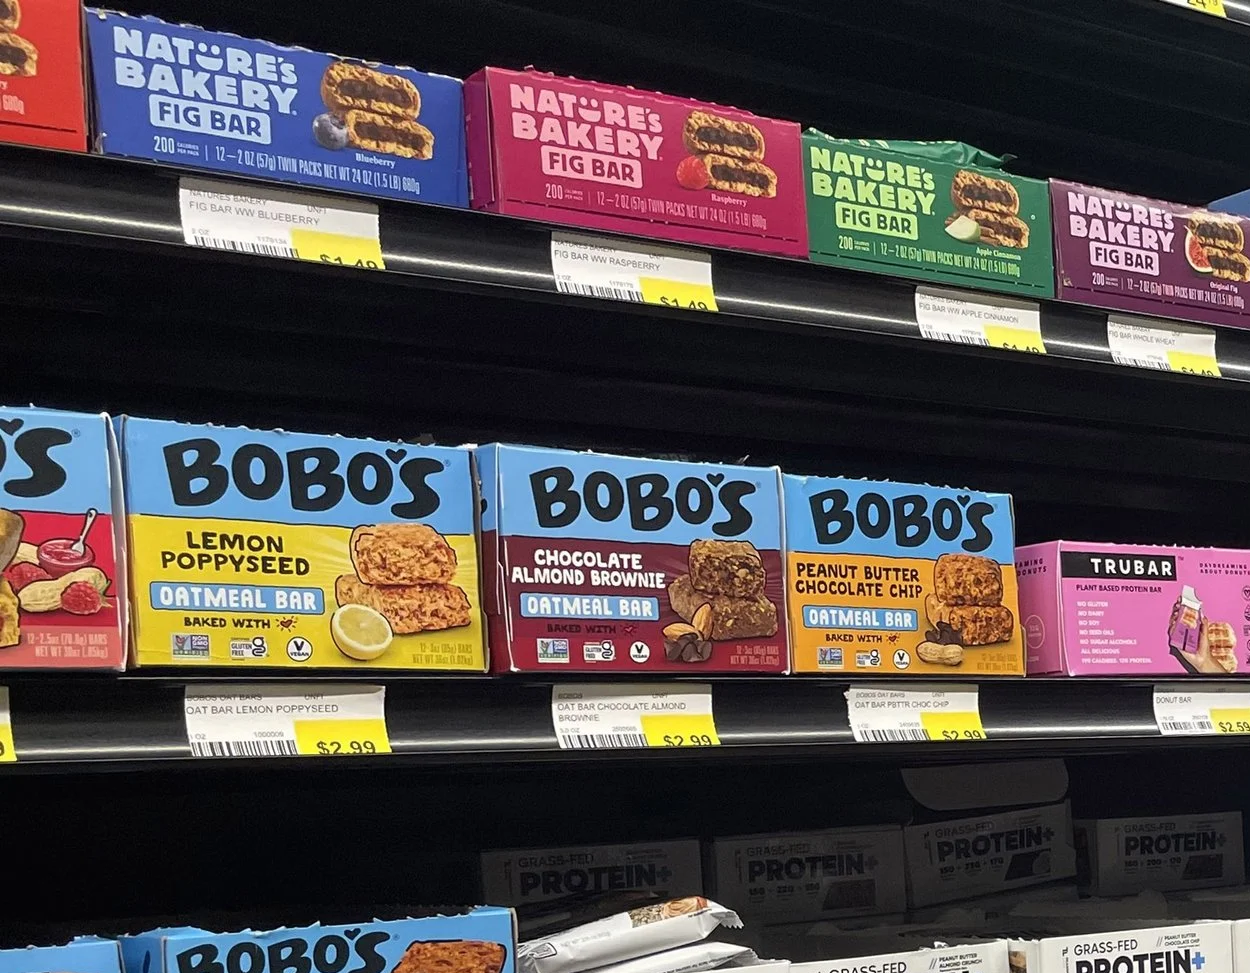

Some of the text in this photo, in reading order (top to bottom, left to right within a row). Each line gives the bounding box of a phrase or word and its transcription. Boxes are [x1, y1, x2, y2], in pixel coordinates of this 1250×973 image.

[114, 57, 297, 115] BAKERY
[159, 101, 262, 138] FIG BAR
[153, 135, 175, 154] 200
[511, 111, 664, 161] BAKERY
[355, 152, 396, 169] Blueberry
[549, 153, 634, 183] FIG BAR
[711, 193, 748, 208] Raspberry
[811, 171, 936, 217] BAKERY
[210, 203, 233, 215] BAR
[257, 208, 320, 226] BLUEBERRY
[841, 207, 912, 235] FIG BAR
[1070, 213, 1174, 254] BAKERY
[976, 246, 1022, 261] Apple Cinnamon
[163, 437, 445, 519] BOBO'S
[529, 466, 756, 537] BOBO'S
[809, 489, 994, 552] BOBO'S
[186, 531, 283, 553] LEMON
[161, 552, 310, 576] POPPYSEED
[534, 549, 642, 570] CHOCOLATE
[1090, 558, 1172, 576] TRUBAR
[512, 567, 665, 589] ALMOND BROWNIE
[797, 563, 919, 582] PEANUT BUTTER
[160, 585, 316, 611] OATMEAL BAR
[795, 580, 922, 599] CHOCOLATE CHIP
[809, 609, 912, 627] OATMEAL BAR
[186, 704, 338, 716] OAT BAR LEMON POPPYSEED
[317, 740, 376, 756] $2.99
[1073, 939, 1138, 956] GRASS-FED
